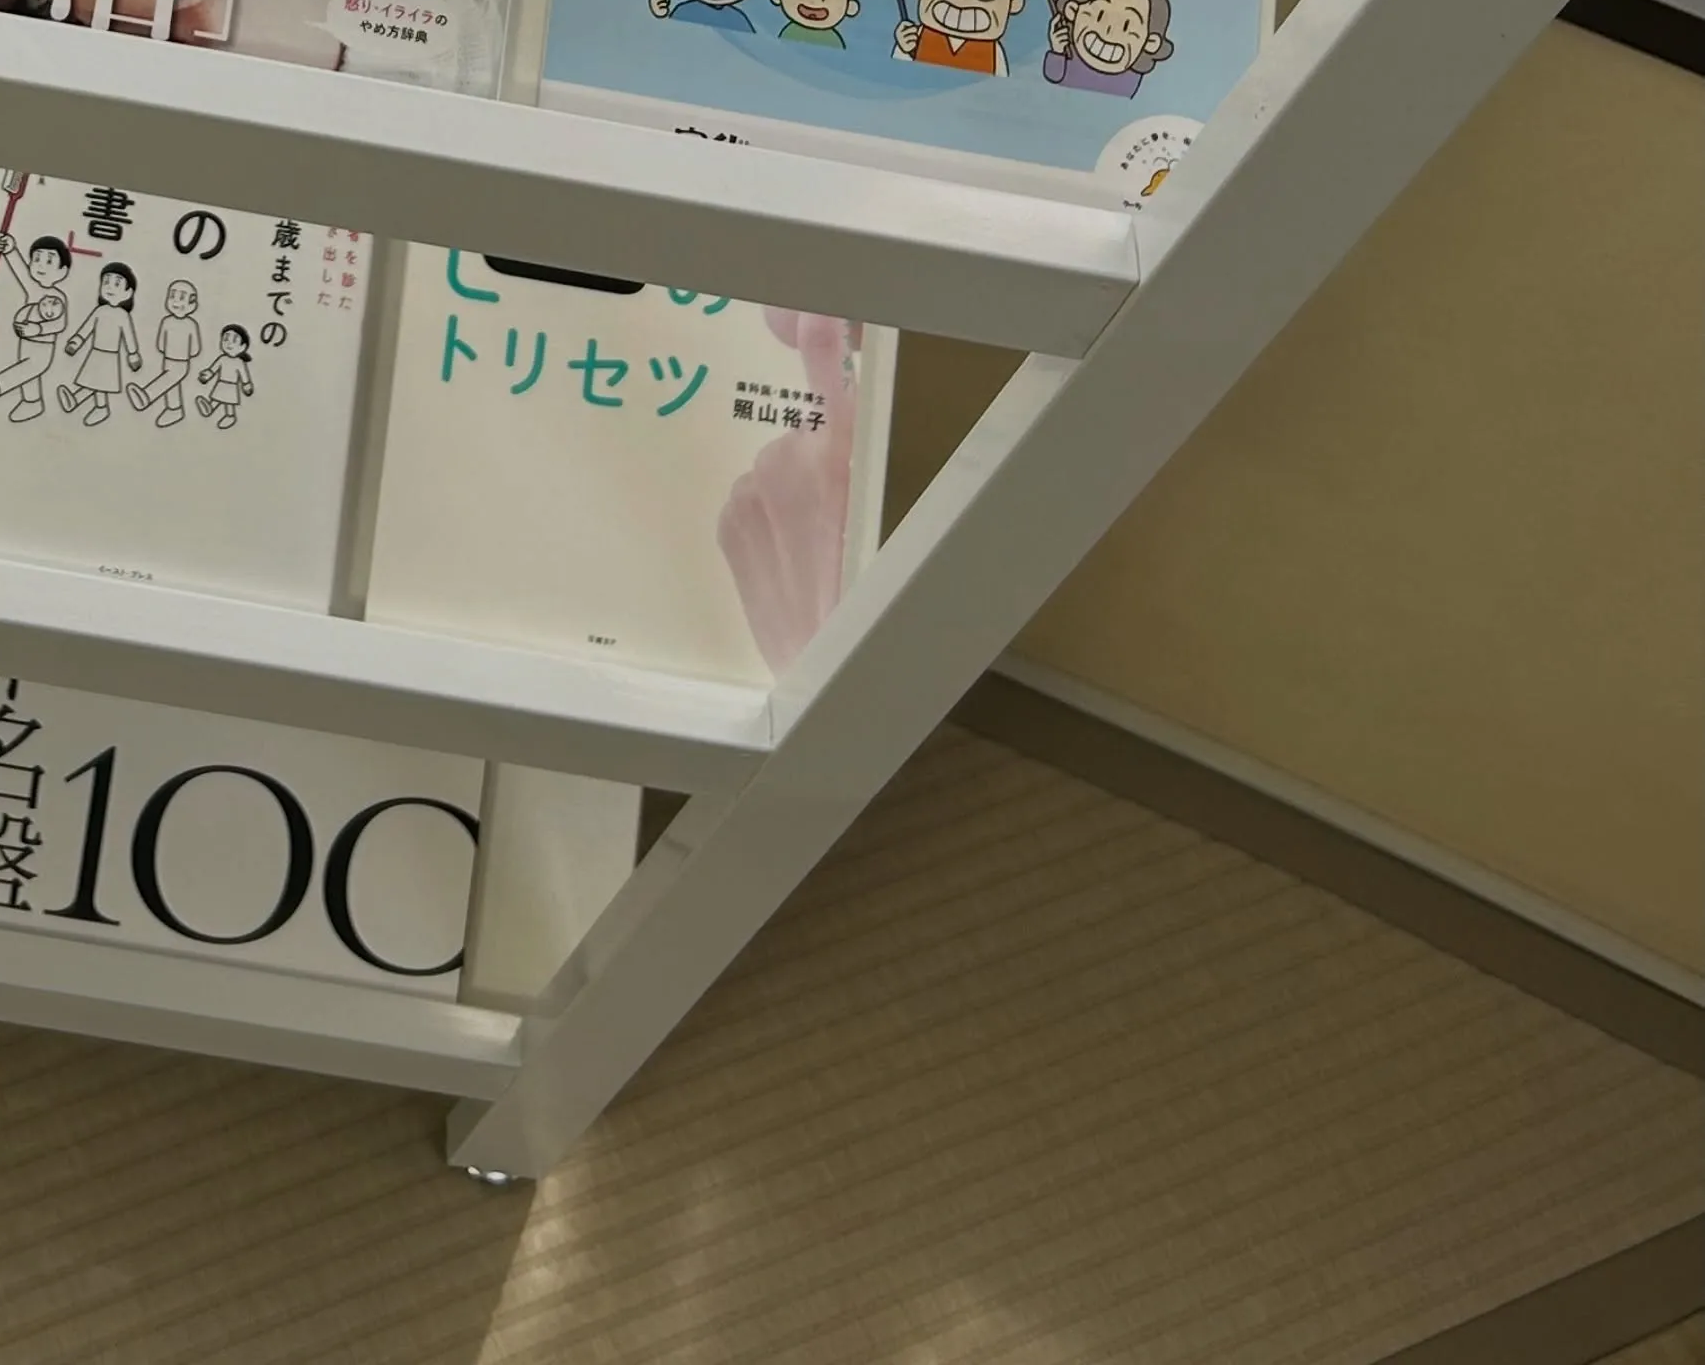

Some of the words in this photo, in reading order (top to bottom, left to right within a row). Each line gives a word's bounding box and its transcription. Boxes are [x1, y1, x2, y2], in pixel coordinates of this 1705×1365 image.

[81, 186, 136, 242] 書
[173, 209, 227, 261] の
[260, 217, 303, 348] 歳までの
[441, 313, 710, 418] トリセツ
[732, 397, 827, 432] 照山裕子
